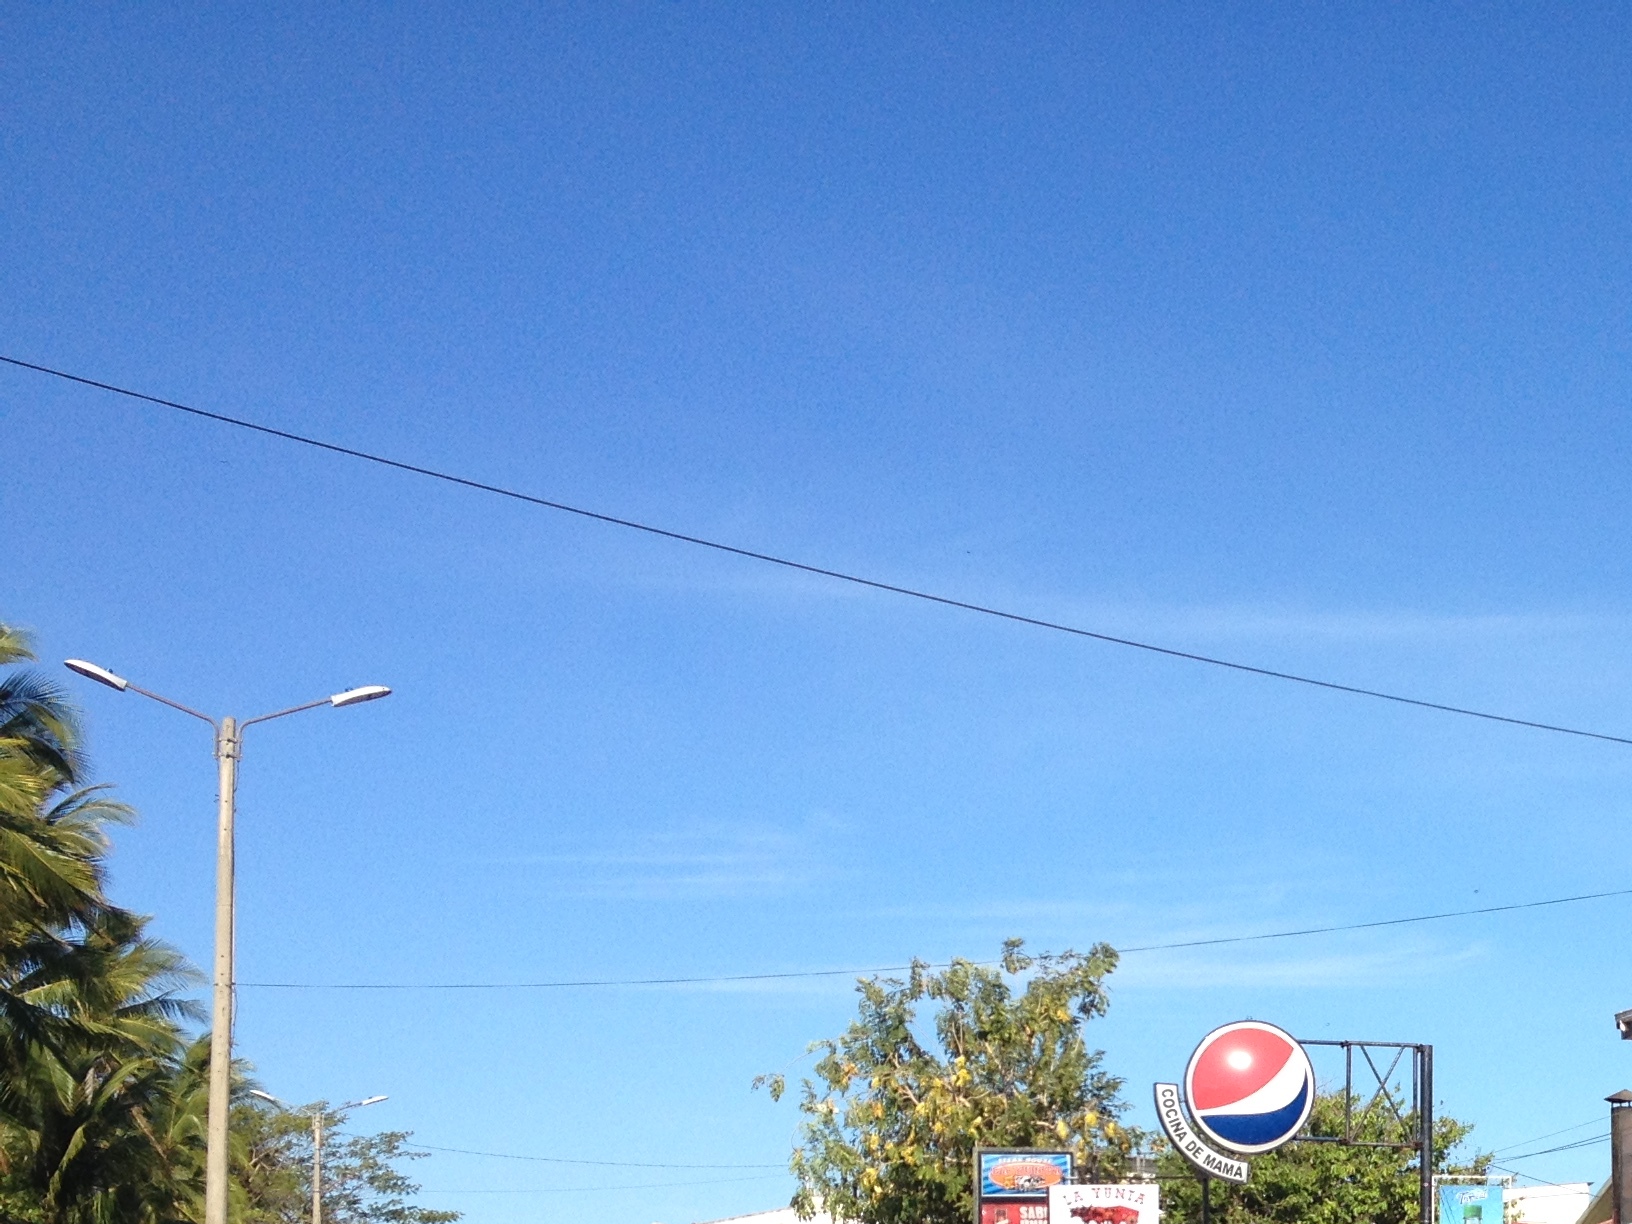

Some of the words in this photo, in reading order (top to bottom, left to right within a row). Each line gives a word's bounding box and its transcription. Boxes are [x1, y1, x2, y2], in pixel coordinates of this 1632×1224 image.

[1161, 1088, 1188, 1142] COCINA
[1185, 1140, 1204, 1160] DE
[1202, 1153, 1243, 1179] MAMÁ
[1062, 1190, 1084, 1206] LA
[1091, 1187, 1146, 1206] YUNTA
